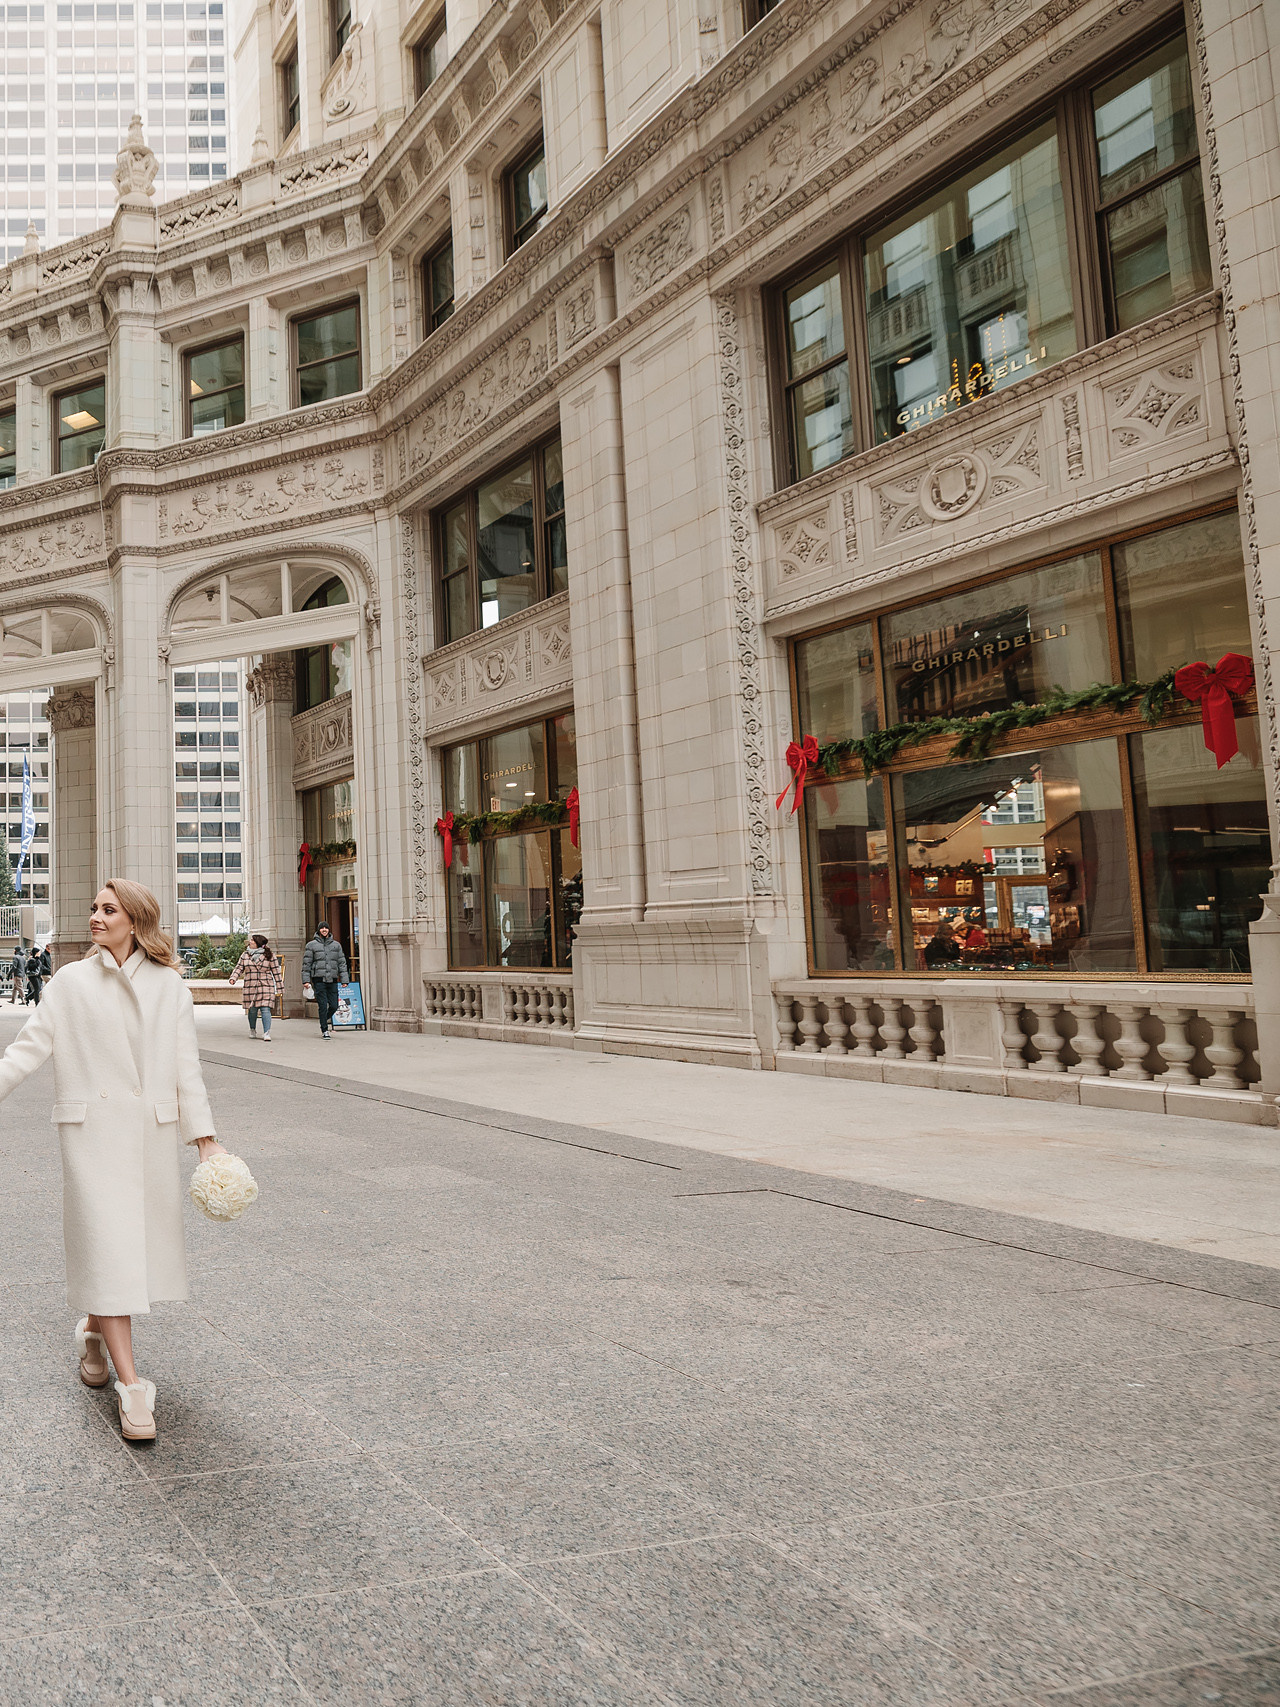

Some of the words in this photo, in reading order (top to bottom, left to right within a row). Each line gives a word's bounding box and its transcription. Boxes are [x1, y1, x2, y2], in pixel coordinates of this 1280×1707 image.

[896, 346, 1047, 425] GHIRARDELLI
[912, 624, 1067, 672] GHIRARDELLI
[483, 761, 540, 781] GHIRARDELL
